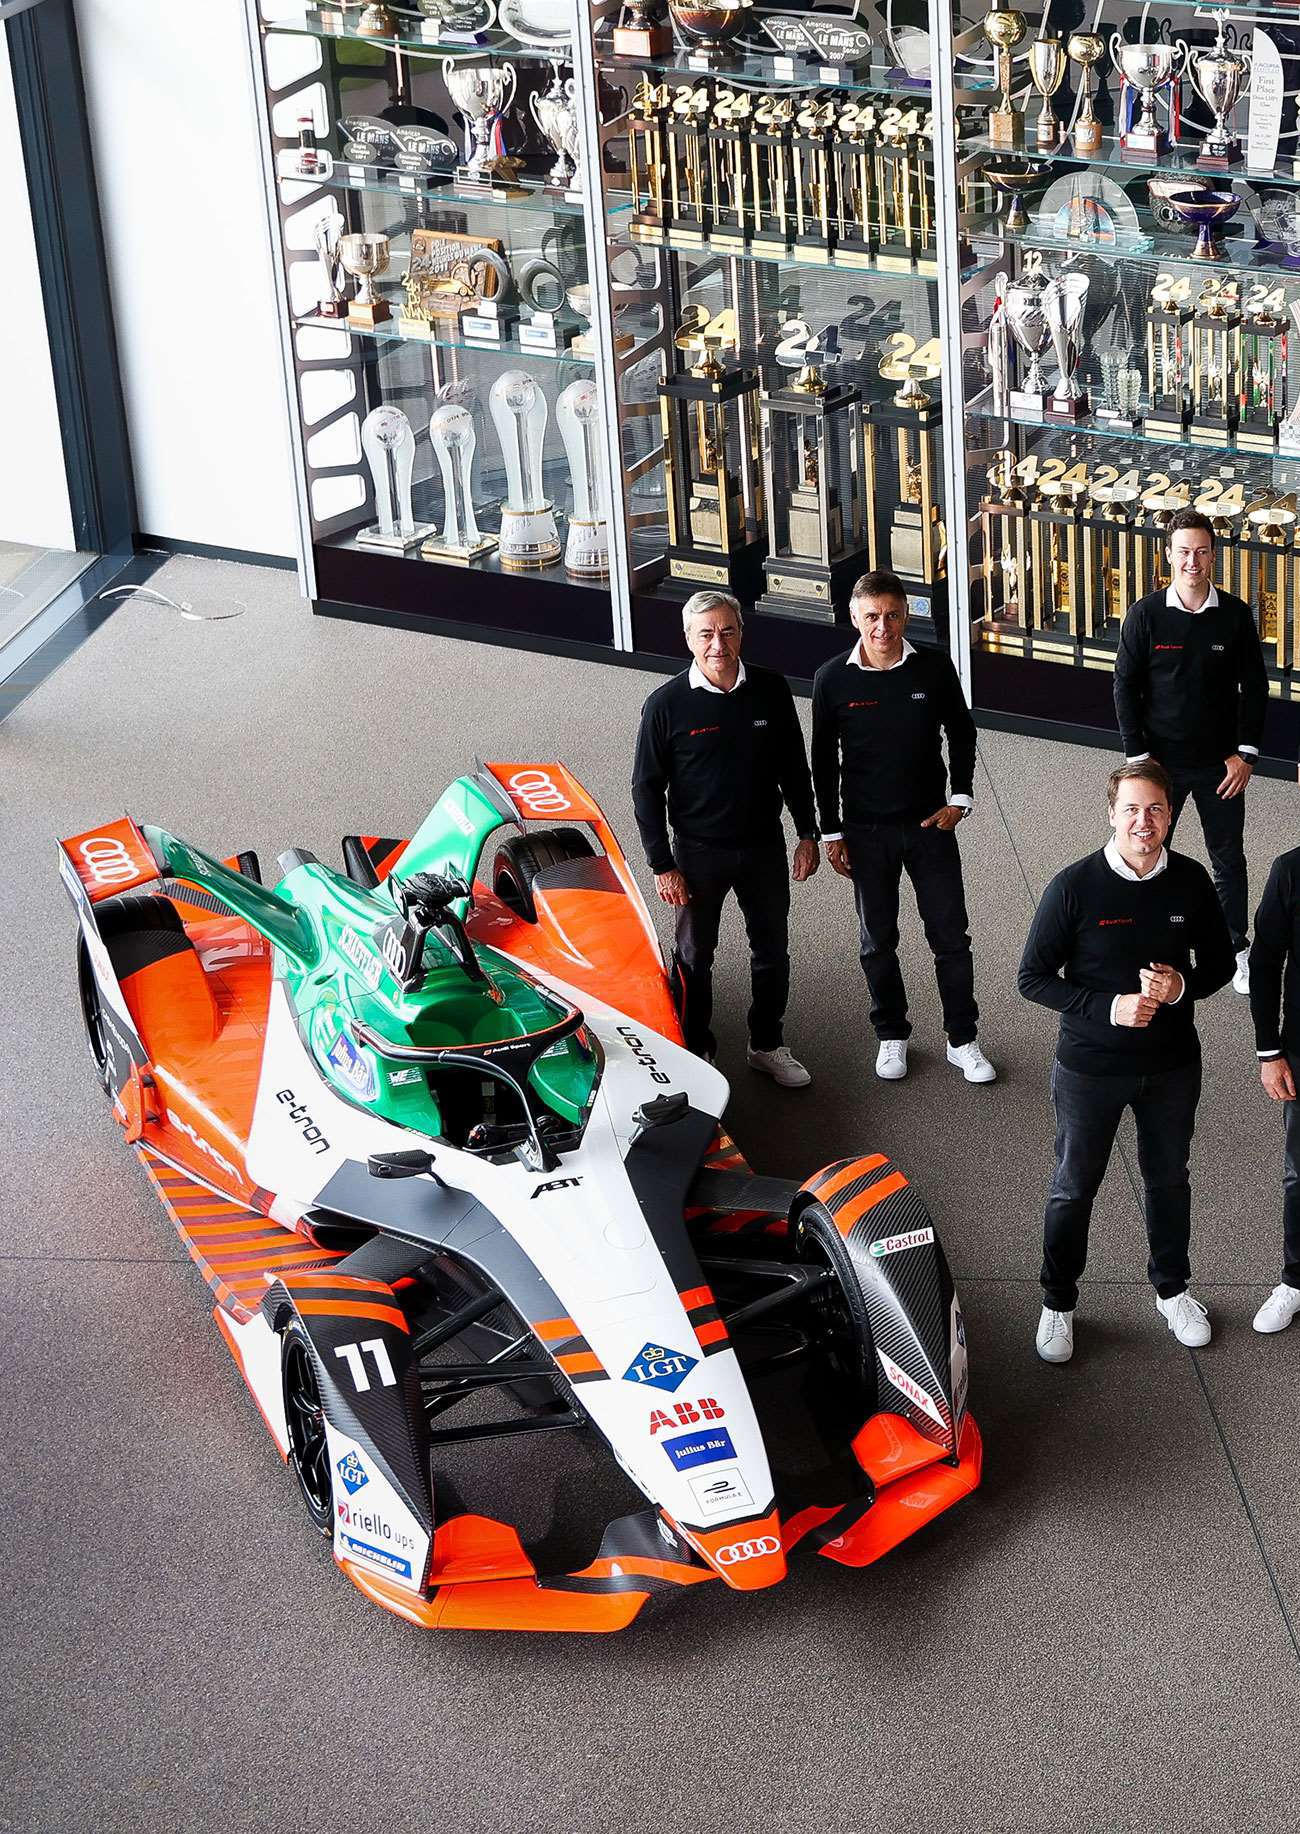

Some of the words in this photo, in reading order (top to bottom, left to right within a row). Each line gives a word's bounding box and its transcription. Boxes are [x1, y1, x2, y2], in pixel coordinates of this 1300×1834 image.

[819, 33, 829, 46] LE
[830, 34, 855, 48] MANS
[829, 52, 845, 60] 2007
[672, 85, 710, 114] 24
[713, 89, 753, 119] 24
[754, 95, 795, 124] 24
[796, 99, 837, 128] 24
[838, 103, 877, 132] 24
[879, 107, 920, 136] 24
[356, 131, 366, 143] LE
[407, 141, 417, 153] LE
[418, 142, 440, 155] MANS
[1022, 250, 1043, 273] 12
[1151, 273, 1192, 302] 24
[1197, 278, 1241, 306] 24
[1245, 284, 1287, 313] 24
[674, 303, 740, 351] 24
[775, 319, 841, 368] 24
[878, 332, 942, 381] 24
[1037, 458, 1090, 496] 24
[1090, 465, 1141, 502] 24
[1140, 472, 1191, 510] 24
[1193, 479, 1246, 517] 24
[1246, 486, 1298, 525] 24
[616, 1026, 671, 1084] e-tron
[276, 1089, 331, 1155] e-tron
[886, 1230, 931, 1252] Castrol
[334, 1337, 397, 1393] 11
[631, 1355, 688, 1383] LGT
[889, 1366, 930, 1410] SONAX
[650, 1398, 725, 1436] ABB
[674, 1442, 706, 1459] Julius
[706, 1438, 727, 1451] Bär
[339, 1461, 366, 1486] LGT
[353, 1507, 392, 1539] riello
[395, 1532, 416, 1550] ups
[350, 1542, 407, 1572] MICHELIN
